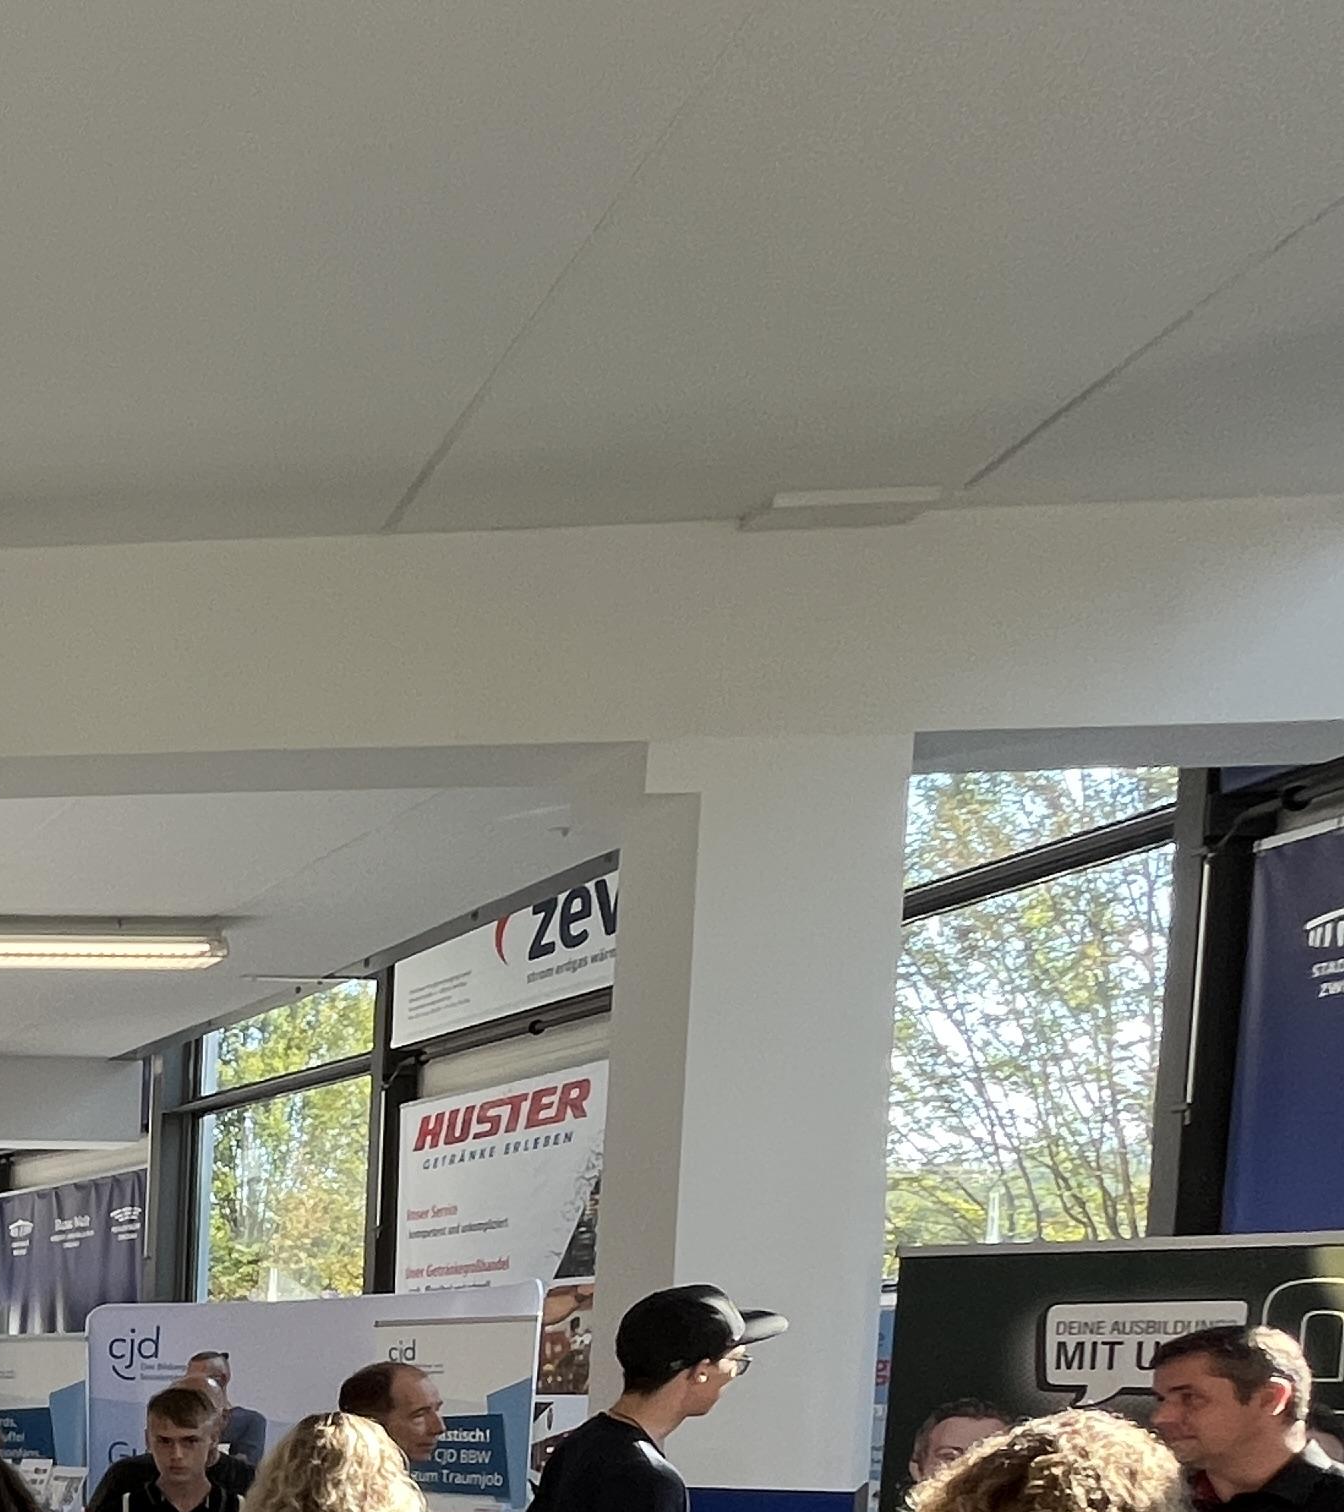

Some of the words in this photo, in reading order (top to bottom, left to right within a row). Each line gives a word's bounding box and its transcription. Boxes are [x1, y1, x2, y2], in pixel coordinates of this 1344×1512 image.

[412, 1078, 591, 1152] HUSTER
[422, 1145, 497, 1170] GETRÄNKE
[503, 1131, 574, 1155] ERLEBEN
[1055, 1319, 1107, 1336] DEINE
[109, 1325, 161, 1370] cjd
[388, 1338, 416, 1363] cjd
[1055, 1340, 1124, 1370] MIT
[434, 1449, 458, 1466] CJD
[460, 1449, 492, 1464] BBW
[442, 1469, 504, 1490] Traumjob
